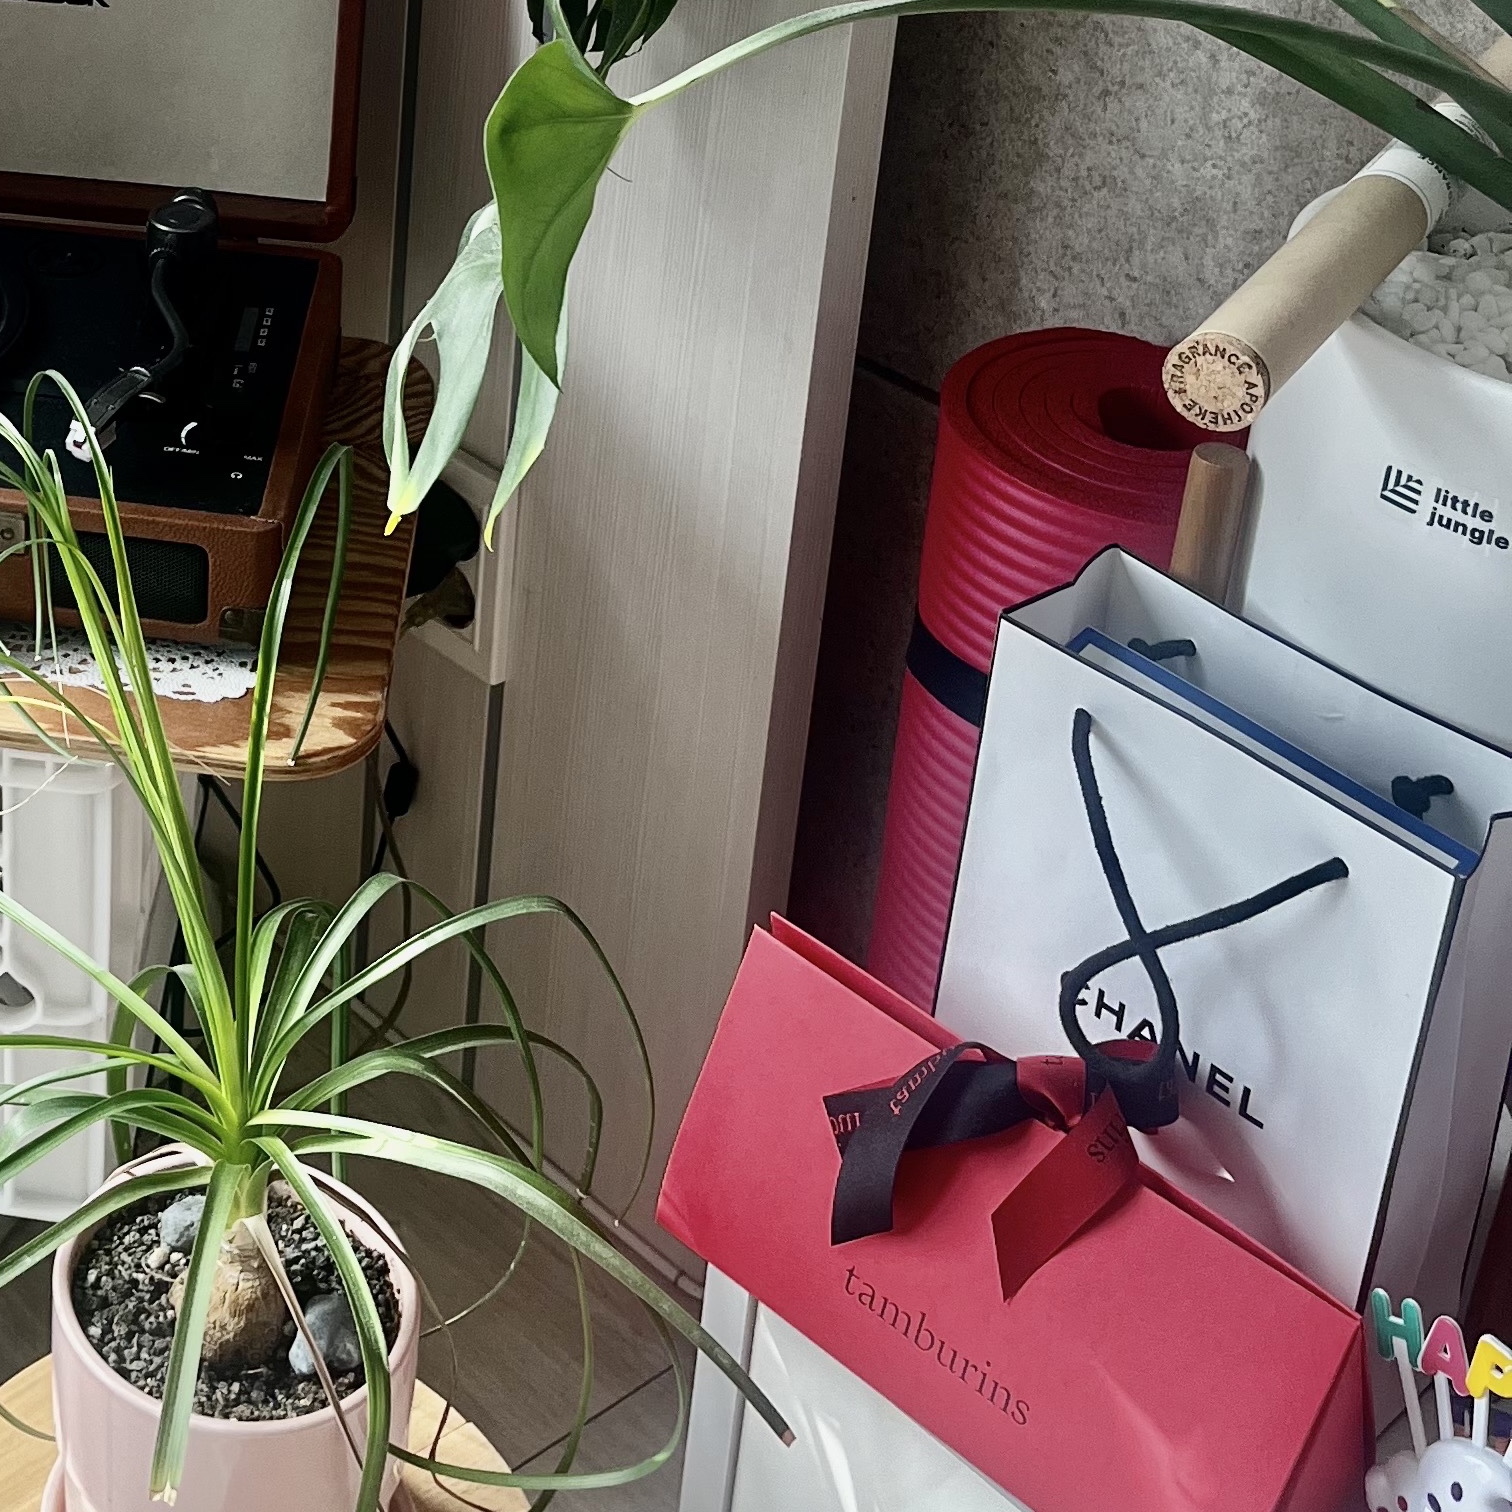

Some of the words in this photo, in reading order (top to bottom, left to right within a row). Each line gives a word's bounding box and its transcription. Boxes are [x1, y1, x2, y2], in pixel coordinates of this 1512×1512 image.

[1426, 506, 1510, 550] jungle
[1433, 486, 1494, 523] little
[844, 1264, 1032, 1428] tamburins
[1370, 1287, 1512, 1400] HAP
